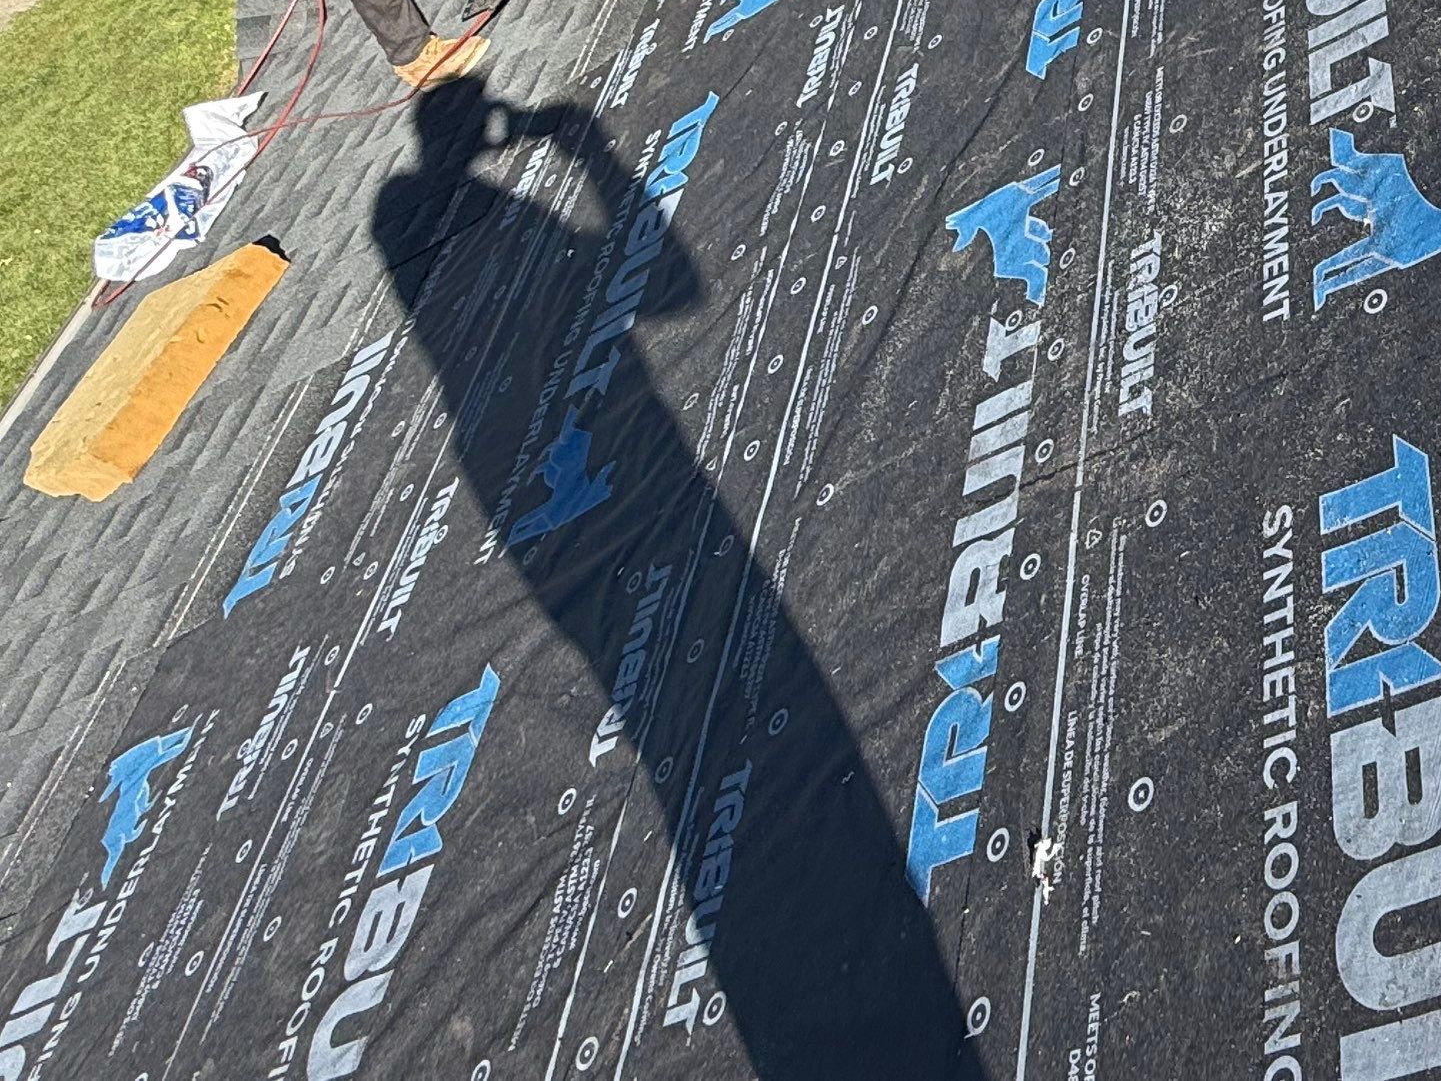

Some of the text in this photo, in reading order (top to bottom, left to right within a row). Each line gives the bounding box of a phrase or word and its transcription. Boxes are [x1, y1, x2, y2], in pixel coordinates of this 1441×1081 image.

[797, 4, 844, 109] TRIBUILT
[870, 61, 920, 187] TRIBUILT
[566, 90, 721, 399] TRIBUILT
[1262, 72, 1291, 322] UNDERLAYMENT
[474, 127, 661, 565] SYNTHETIC ROOFING UNDERLAYMENT
[1117, 230, 1163, 418] TRIBUILT
[377, 476, 459, 642] TRIBUILT
[1077, 574, 1090, 627] OVERLAP
[589, 562, 675, 768] TRIBUILT
[1261, 503, 1296, 790] SYNTHETIC
[217, 645, 312, 821] TRIBUILT
[1063, 750, 1074, 769] DE
[267, 713, 427, 1081] SYNTHETIC ROOFI
[305, 661, 501, 1081] TRIBU
[552, 875, 572, 913] ASTM
[565, 865, 584, 903] ASTM
[662, 757, 754, 1034] TRIBUILT
[1093, 869, 1102, 893] roof
[1095, 845, 1103, 867] and
[1096, 796, 1108, 843] footwear
[1085, 992, 1101, 1056] MEETS
